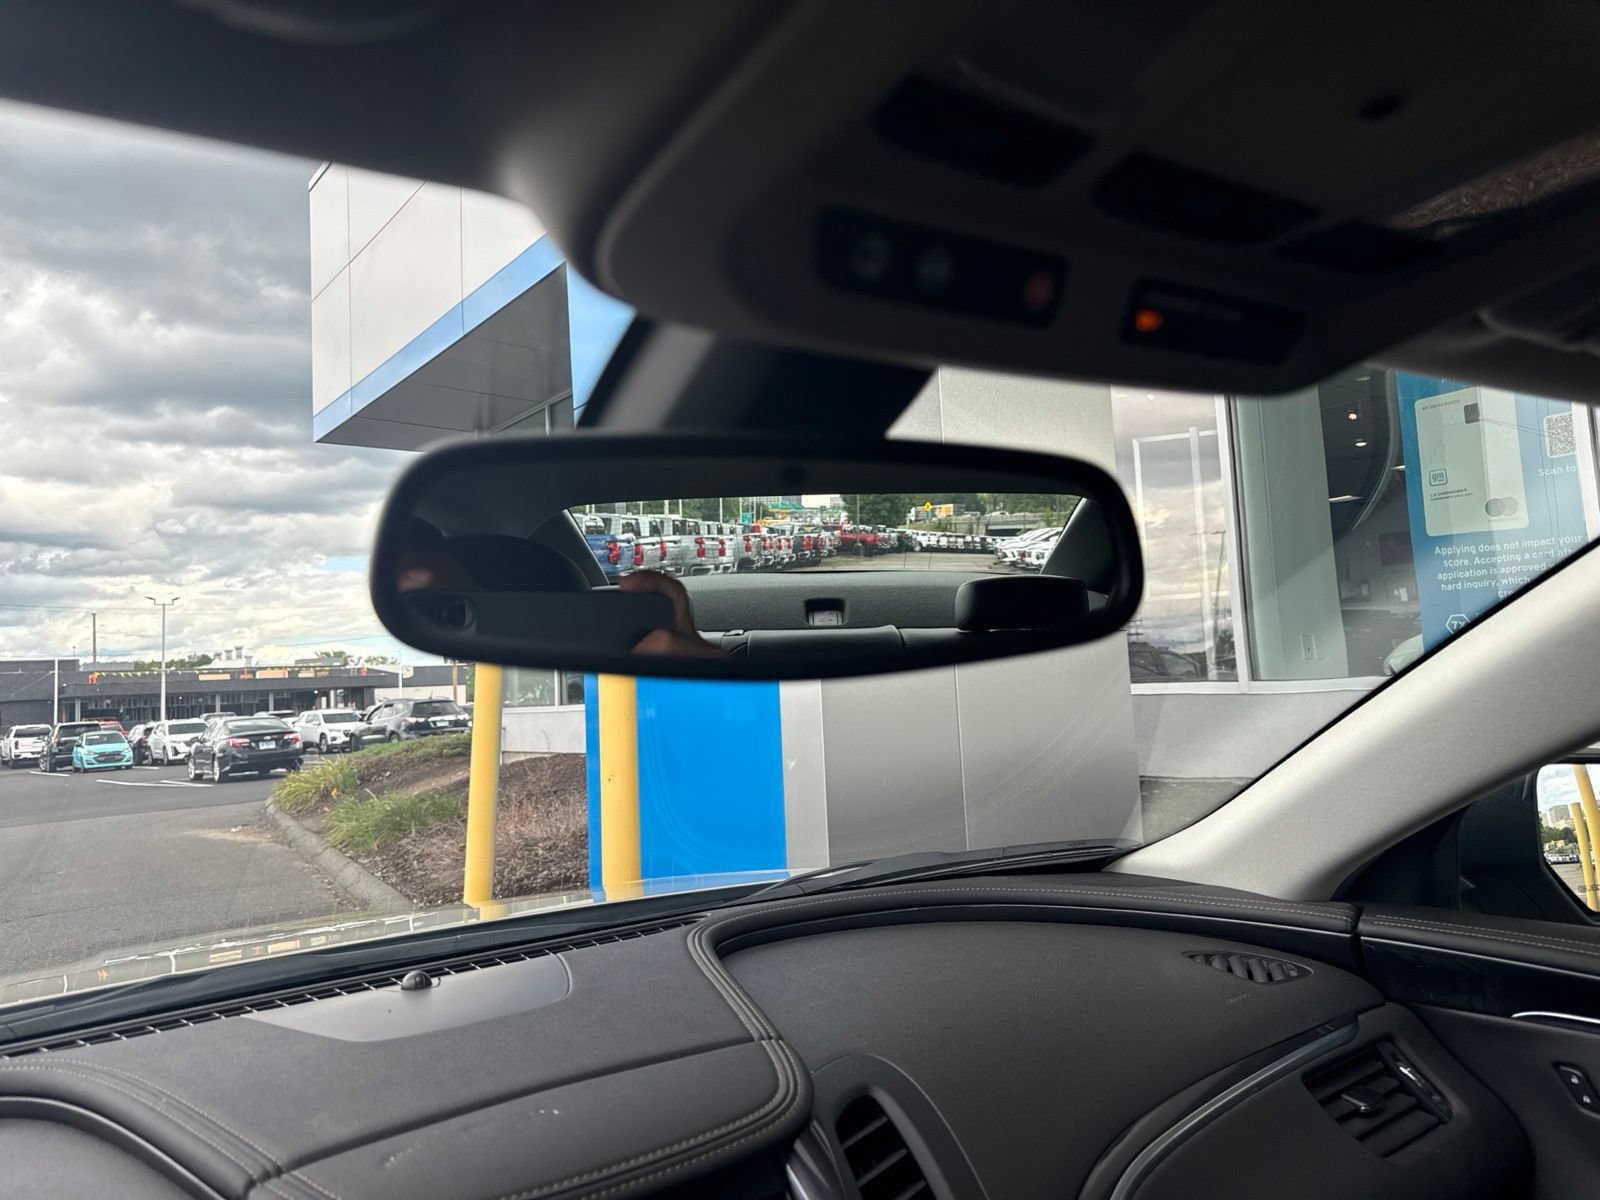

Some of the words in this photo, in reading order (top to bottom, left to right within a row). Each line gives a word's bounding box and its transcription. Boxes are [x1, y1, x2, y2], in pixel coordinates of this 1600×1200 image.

[1537, 467, 1563, 477] Scan
[1565, 465, 1577, 473] to
[1434, 545, 1476, 556] Applying
[1478, 543, 1501, 553] does
[1503, 541, 1519, 550] not
[1521, 537, 1556, 549] impact
[1558, 534, 1583, 547] your
[1443, 556, 1472, 567] score.
[1473, 553, 1521, 566] Accepting
[1532, 549, 1555, 559] card
[1437, 568, 1488, 581] application
[1489, 567, 1498, 575] is
[1500, 562, 1547, 575] approved
[1441, 582, 1462, 592] hard
[1501, 575, 1530, 586] which
